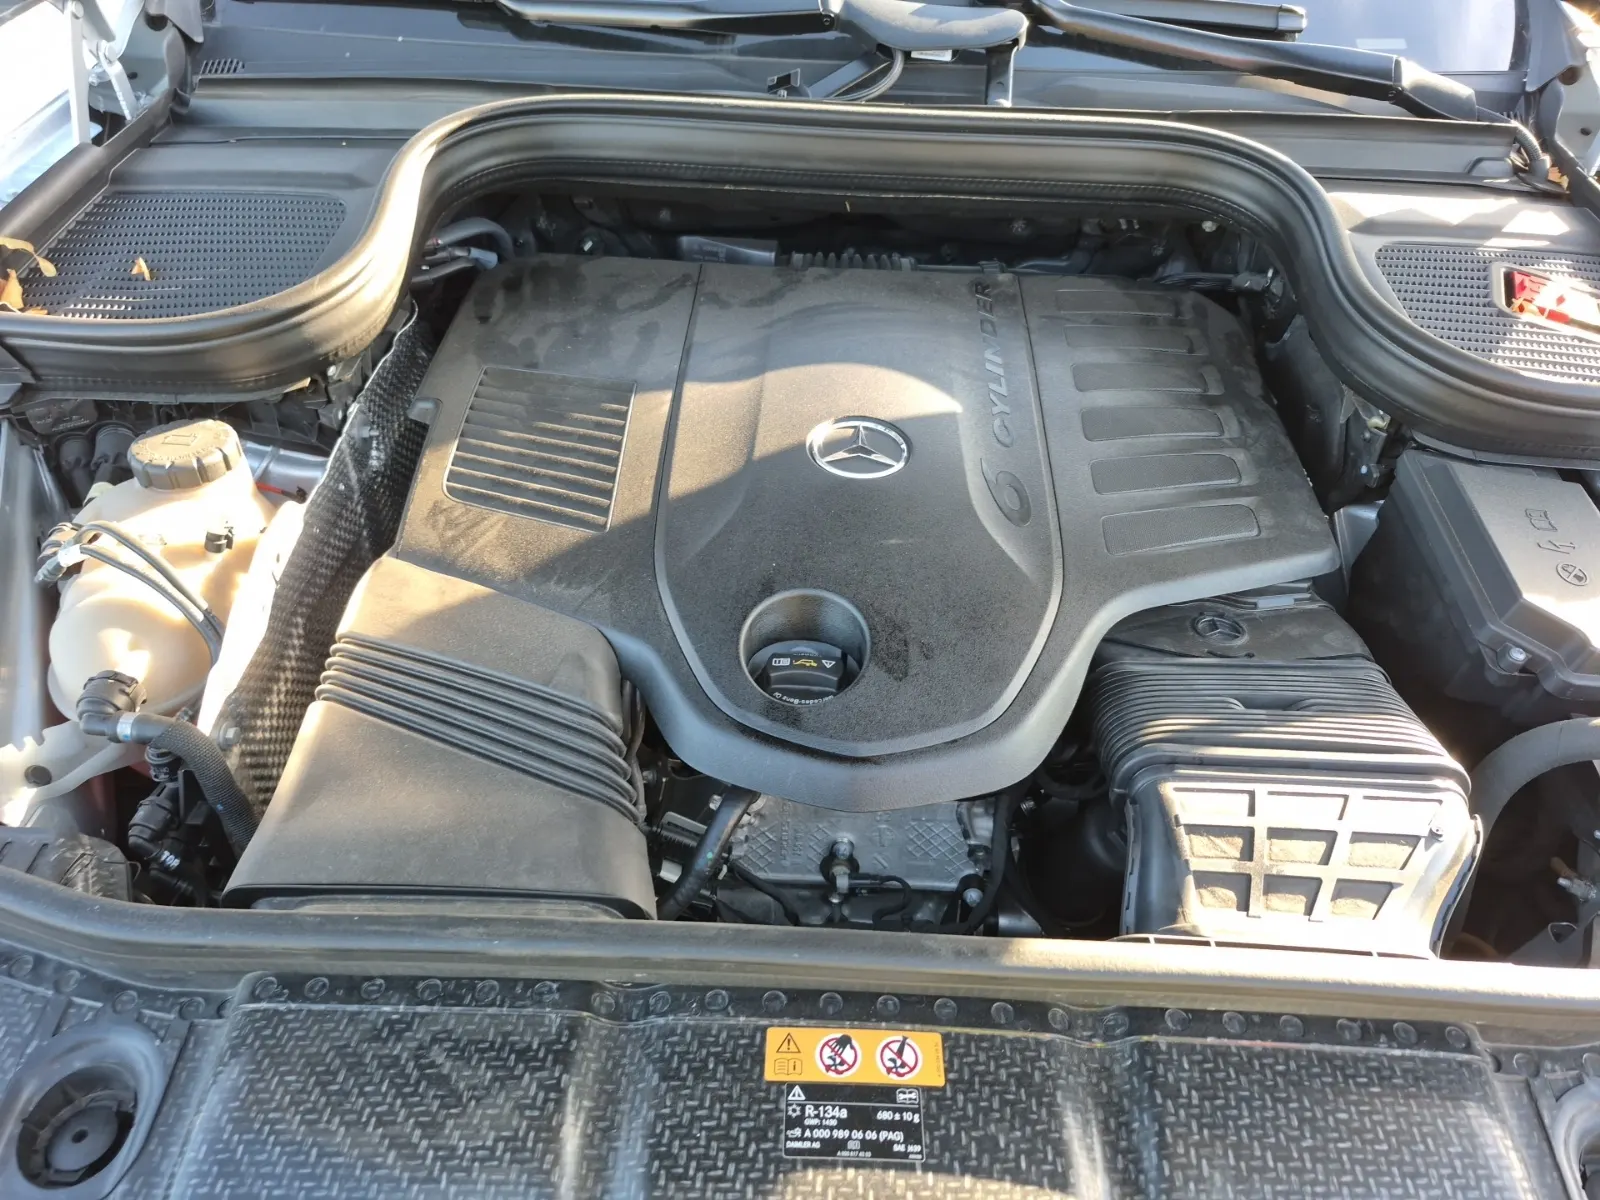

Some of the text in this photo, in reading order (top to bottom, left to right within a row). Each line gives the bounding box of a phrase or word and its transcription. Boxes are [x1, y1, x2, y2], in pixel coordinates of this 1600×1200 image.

[974, 282, 1032, 527] 6 CYLINDER
[804, 1104, 848, 1119] R-134a
[876, 1110, 893, 1121] 680
[902, 1111, 913, 1122] 10
[804, 1128, 905, 1143] A 000 989 06 06 (PAG)
